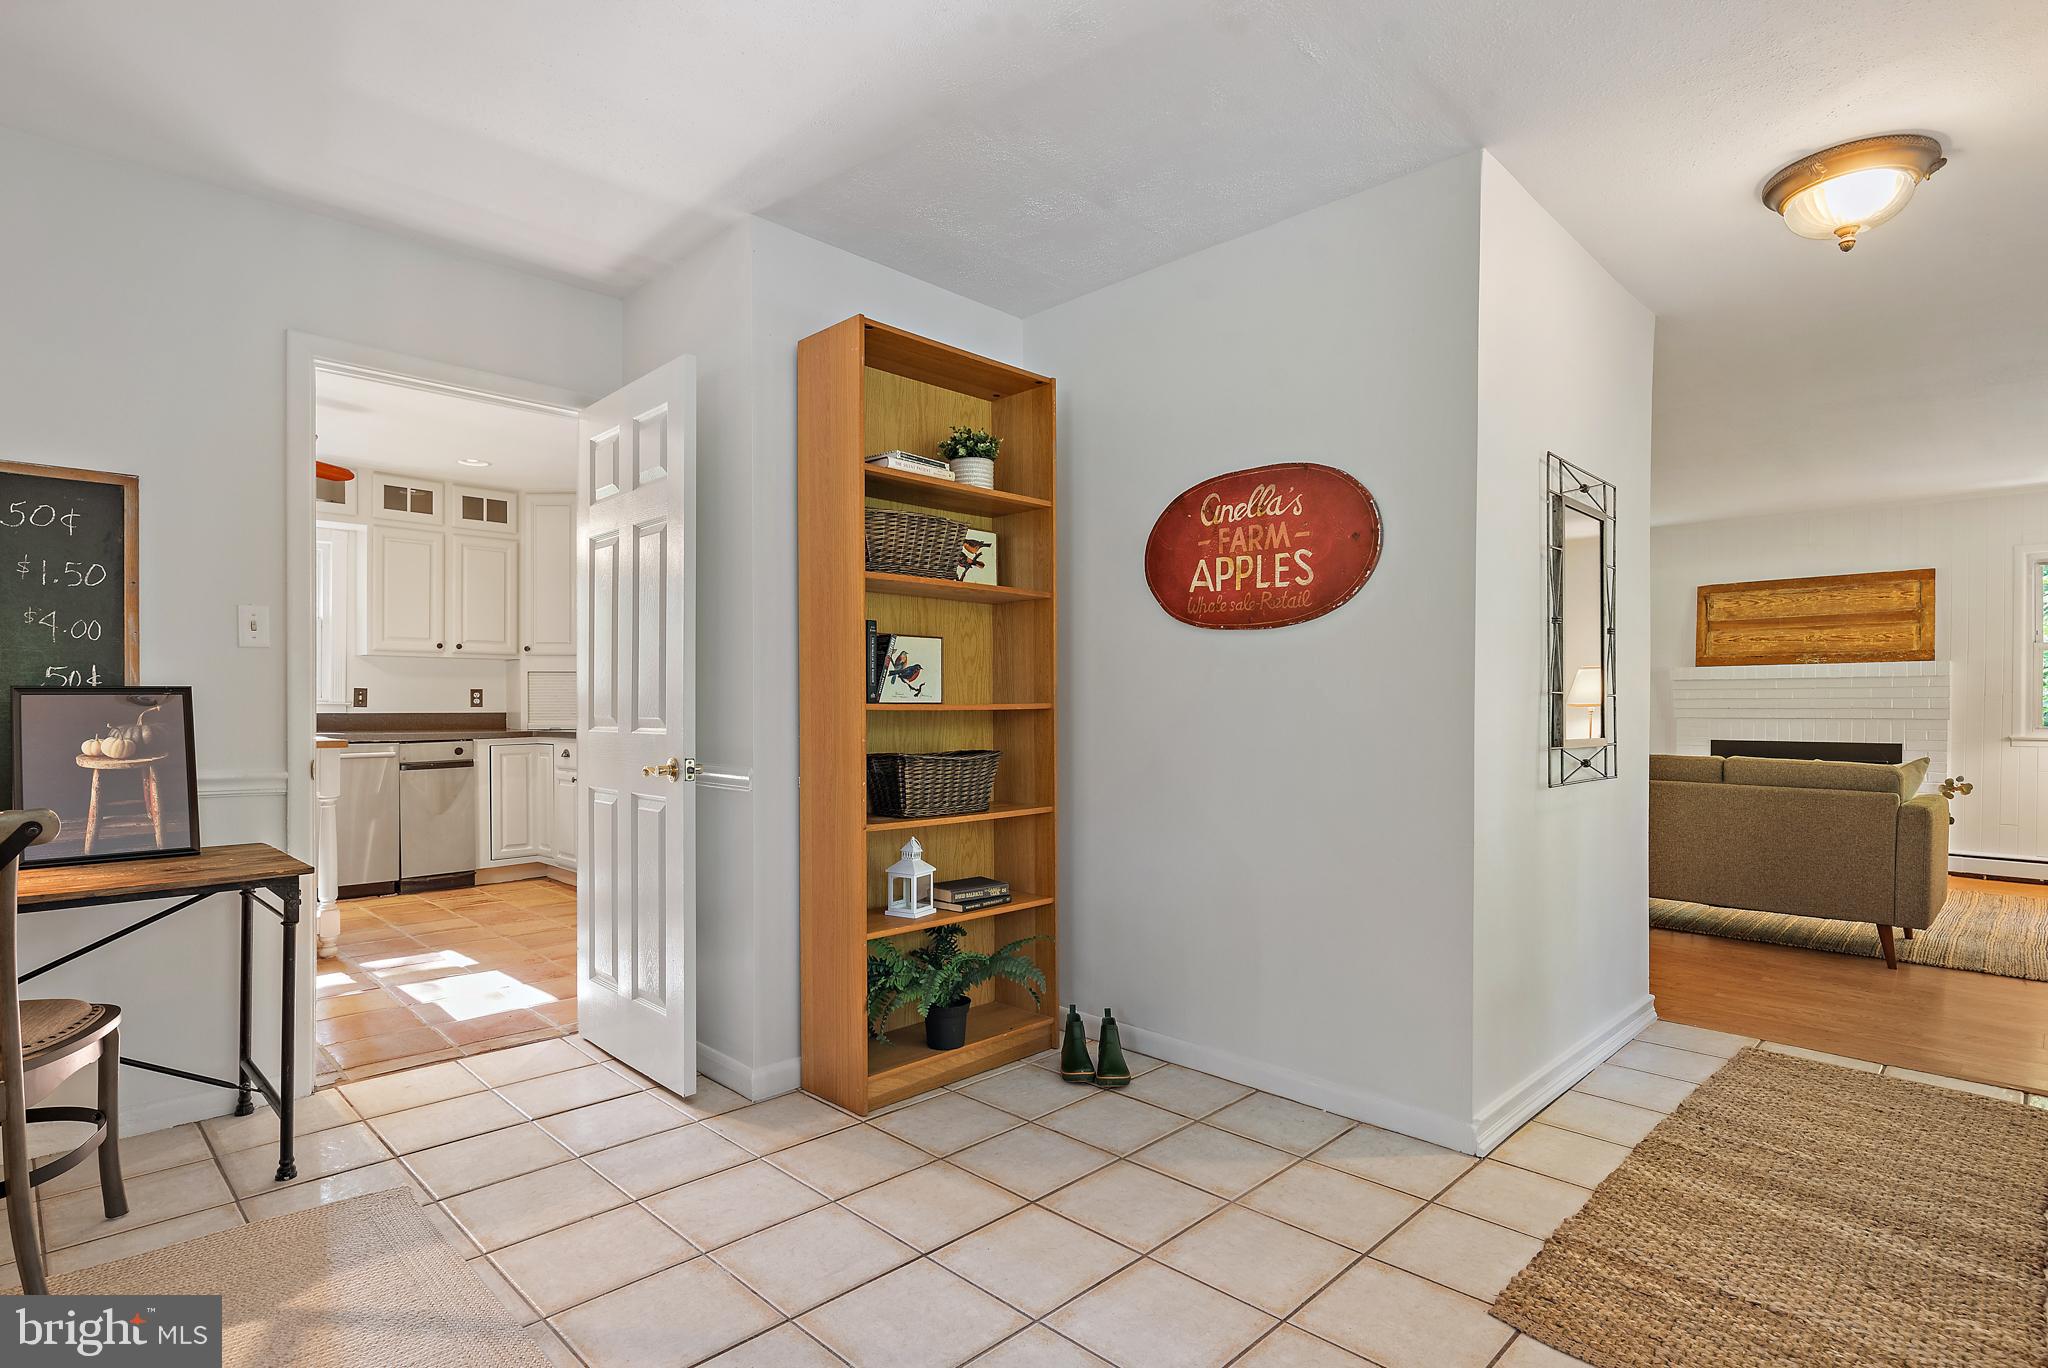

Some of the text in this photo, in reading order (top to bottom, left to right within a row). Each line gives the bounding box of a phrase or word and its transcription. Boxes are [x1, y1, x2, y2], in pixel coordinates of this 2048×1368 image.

[16, 554, 107, 587] $1.50
[1189, 548, 1315, 593] APPLES
[24, 606, 101, 642] $4.00
